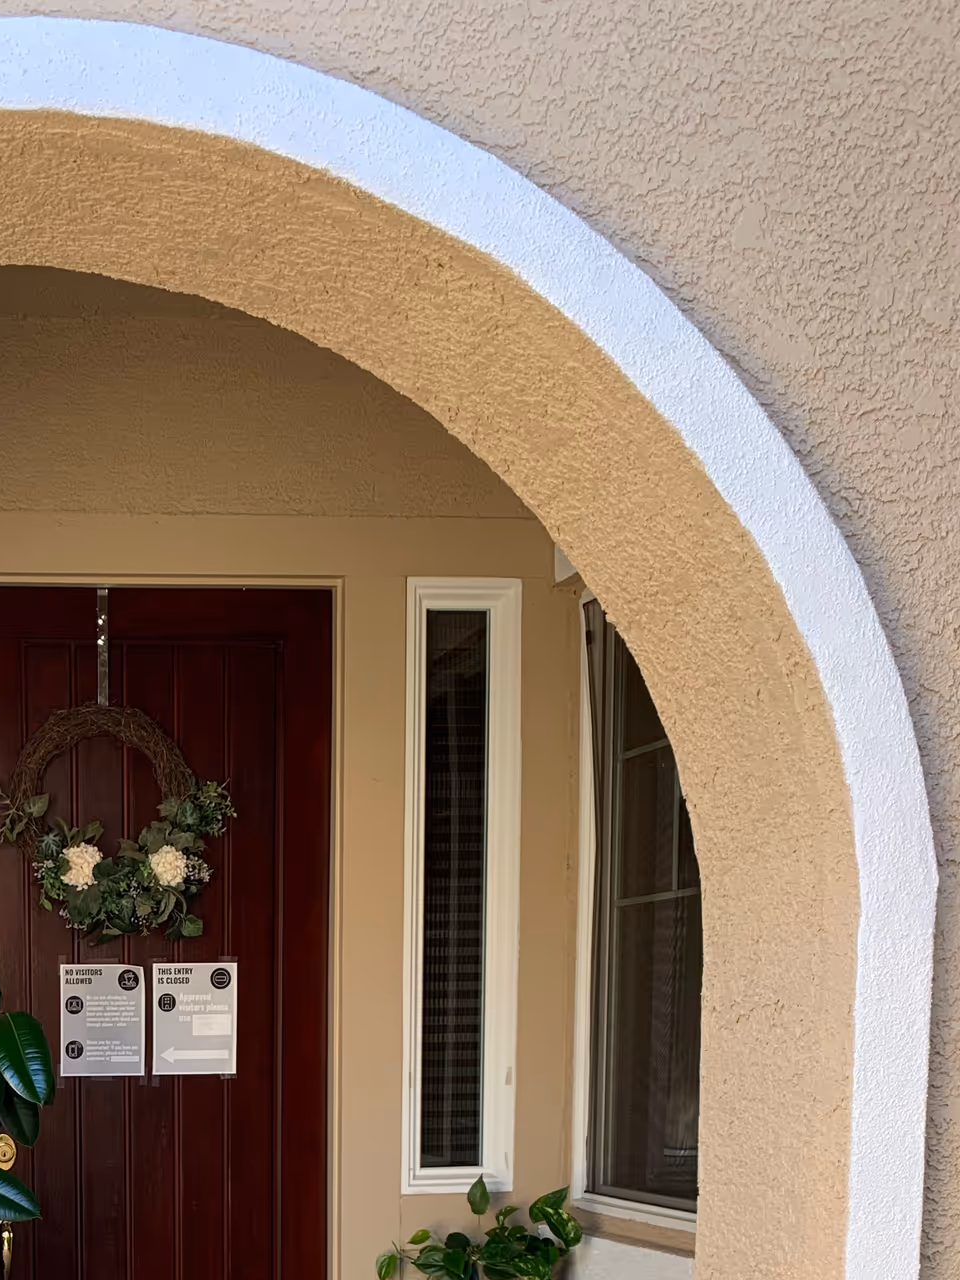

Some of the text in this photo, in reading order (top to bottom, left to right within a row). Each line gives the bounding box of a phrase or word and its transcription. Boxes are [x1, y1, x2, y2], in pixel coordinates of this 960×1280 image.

[157, 967, 193, 975] THIS ENTRY
[179, 993, 211, 1002] Approved
